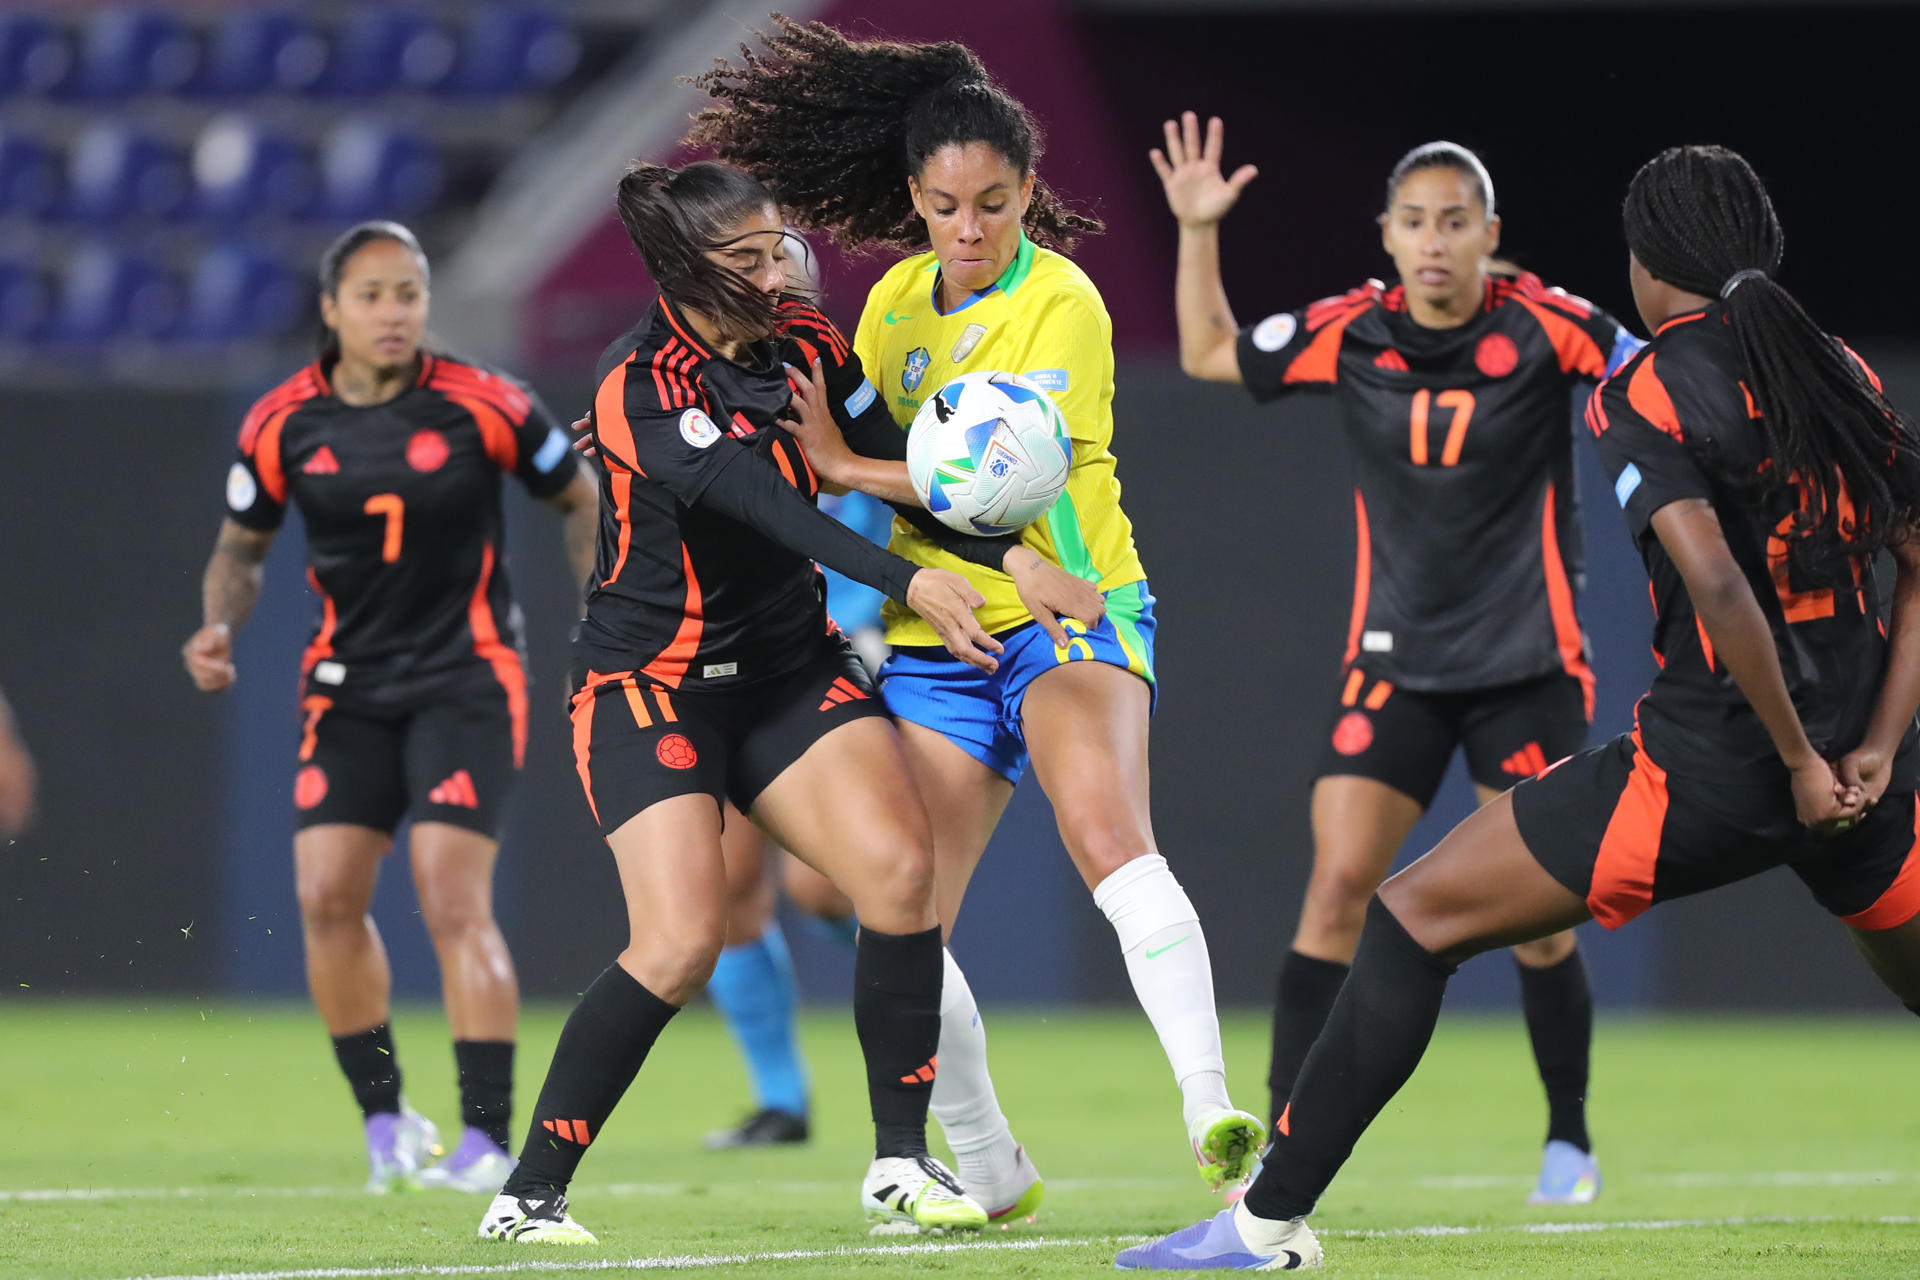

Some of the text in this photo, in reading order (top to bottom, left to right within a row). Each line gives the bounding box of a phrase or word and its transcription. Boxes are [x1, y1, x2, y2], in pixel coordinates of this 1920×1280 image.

[910, 366, 921, 374] CBF
[1410, 388, 1476, 467] 17
[364, 493, 405, 564] 7
[298, 694, 335, 762] 7
[621, 678, 679, 728] 11
